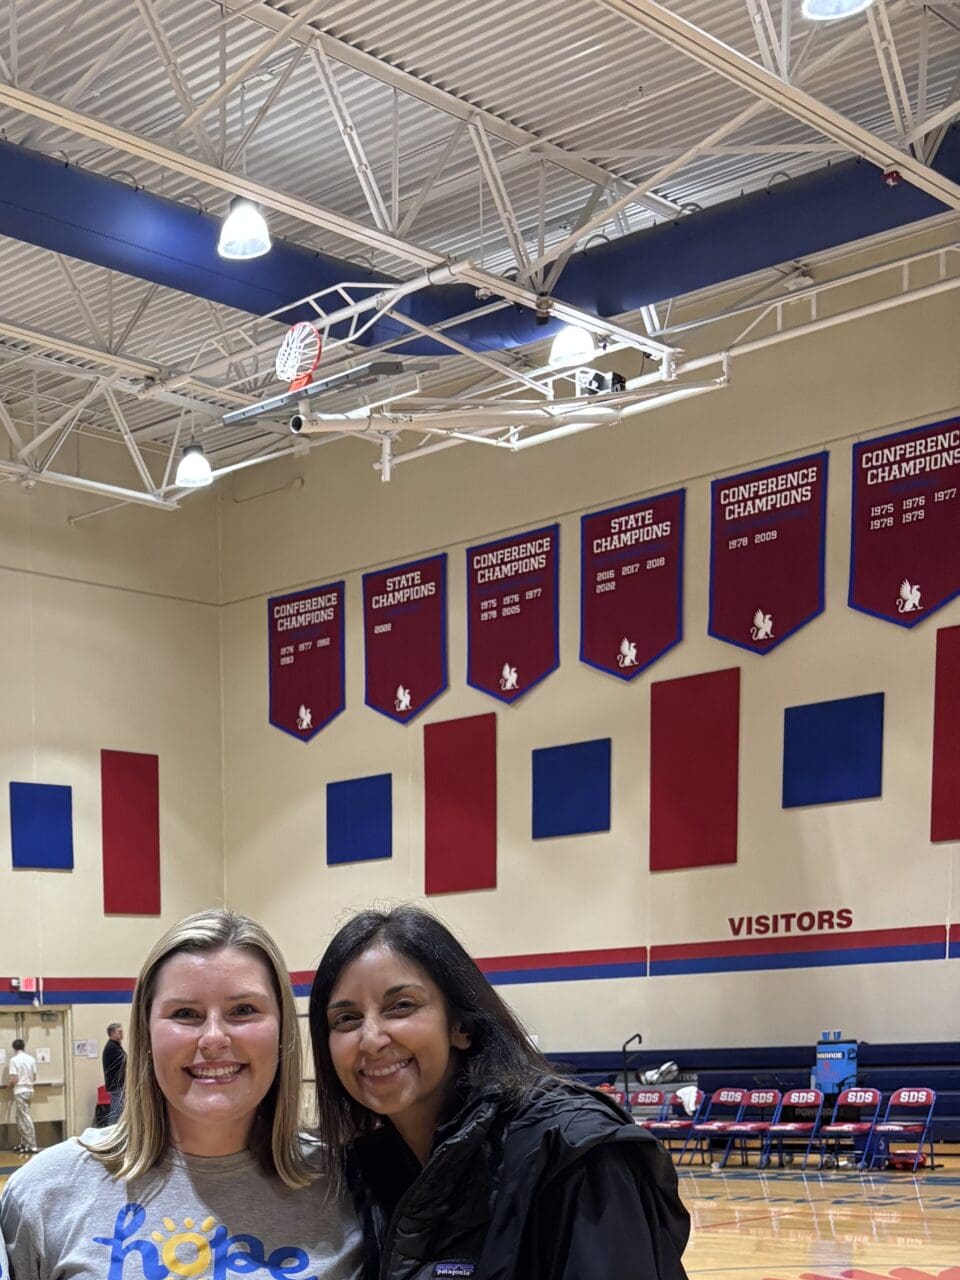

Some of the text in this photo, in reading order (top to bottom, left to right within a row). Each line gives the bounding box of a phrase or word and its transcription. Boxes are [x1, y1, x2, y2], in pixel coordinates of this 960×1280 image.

[862, 430, 960, 468] CONFERENC
[720, 467, 817, 504] CONFERENCE
[725, 486, 811, 520] CHAMPIONS
[871, 488, 956, 516] 1975 1976 1977
[610, 509, 653, 533] STATE
[870, 509, 924, 530] 1978 1979
[593, 521, 671, 554] CHAMPIONS
[728, 530, 777, 550] 1978 2009
[473, 537, 550, 569] CONFERENCE
[477, 554, 546, 584] CHAMPIONS
[621, 563, 640, 575] 2017
[386, 571, 421, 591] STATE
[274, 593, 337, 618] CONFERENCE
[372, 582, 436, 609] CHAMPIONS
[525, 588, 542, 600] 1977
[277, 608, 334, 631] CHAMPIONS
[728, 908, 853, 936] VISITORS
[638, 1092, 660, 1103] SDS
[719, 1091, 742, 1102] SDS
[751, 1092, 774, 1103] SDS
[790, 1092, 816, 1104] SDS
[847, 1091, 874, 1104] SDS
[899, 1091, 927, 1103] SDS
